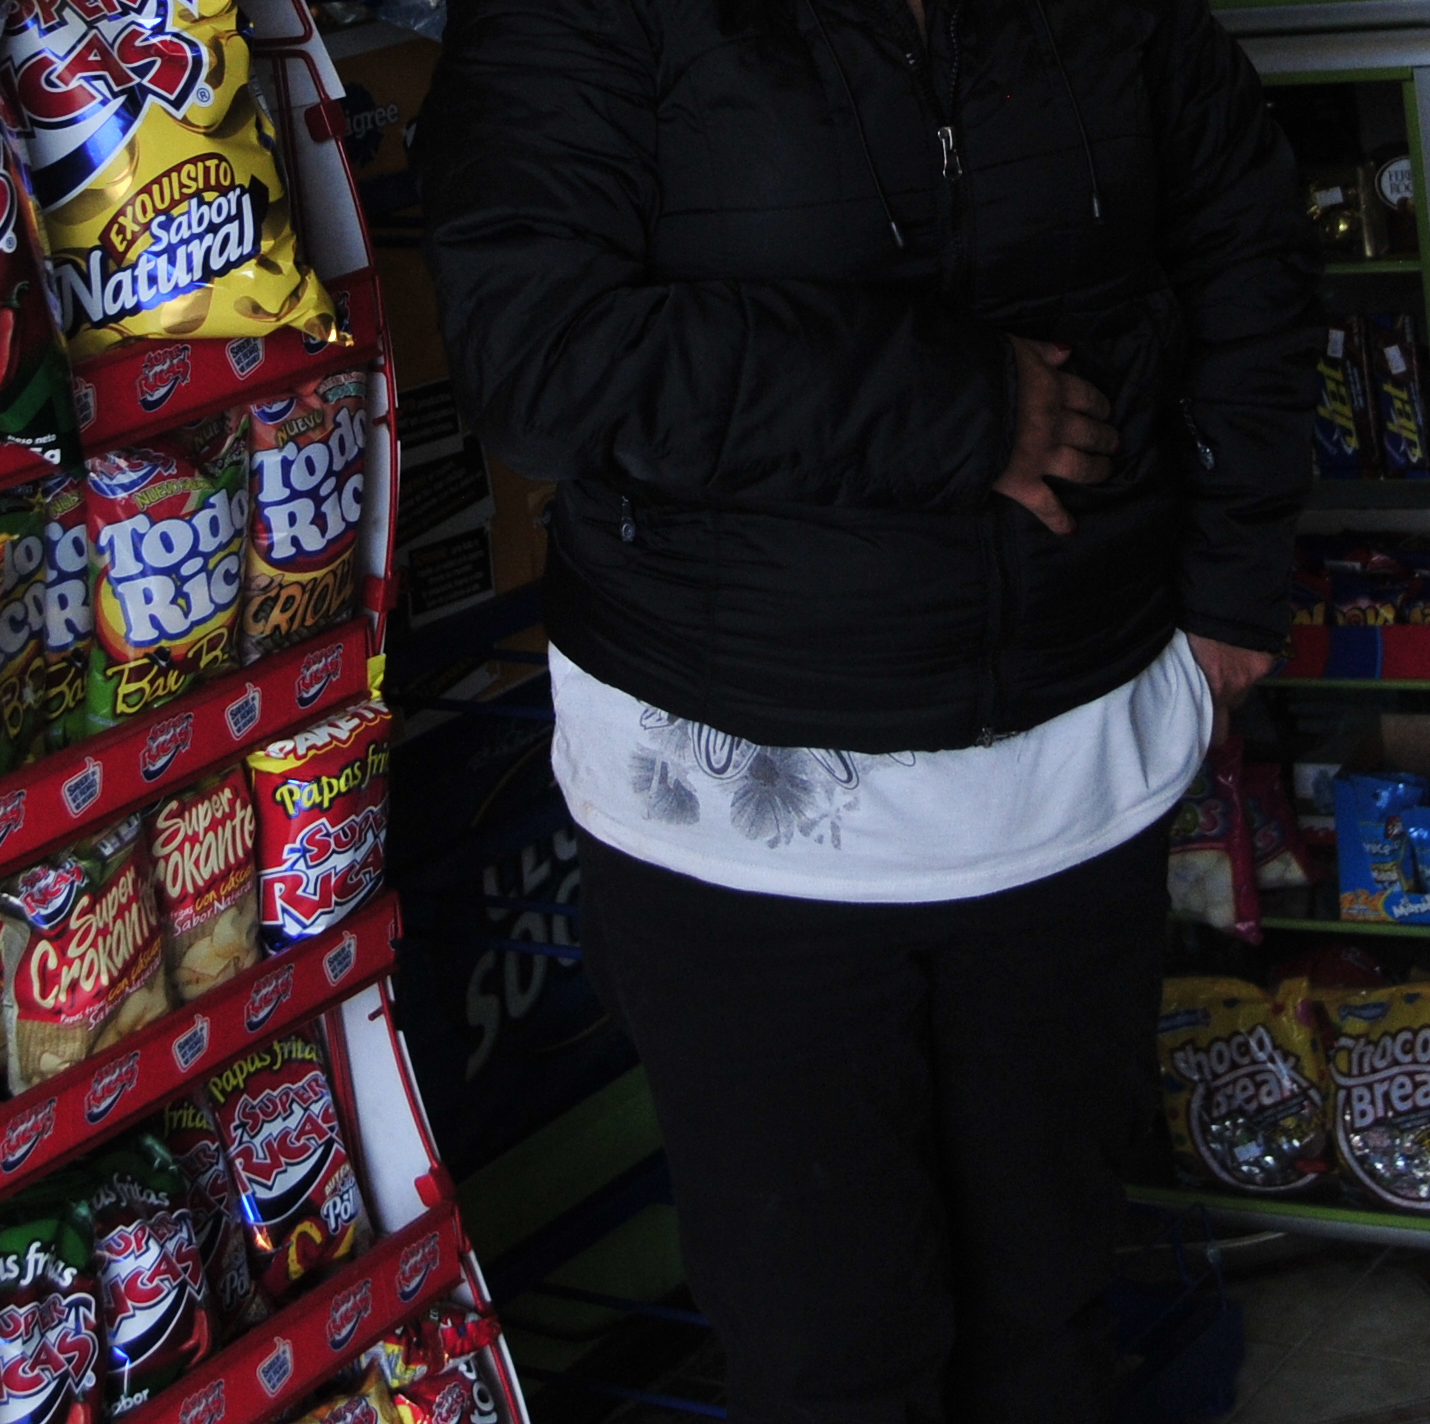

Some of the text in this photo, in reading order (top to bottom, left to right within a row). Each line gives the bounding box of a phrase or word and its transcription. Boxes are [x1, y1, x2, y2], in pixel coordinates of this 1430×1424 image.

[110, 159, 233, 249] EXQUISITO
[151, 185, 243, 246] Sabor
[64, 192, 255, 324] Natural
[251, 405, 367, 503] Todo
[100, 487, 248, 577] Todo
[152, 786, 233, 858] Super
[275, 759, 363, 817] Papas
[155, 798, 257, 900] okante
[68, 865, 135, 951] Super
[172, 908, 214, 938] Sabor
